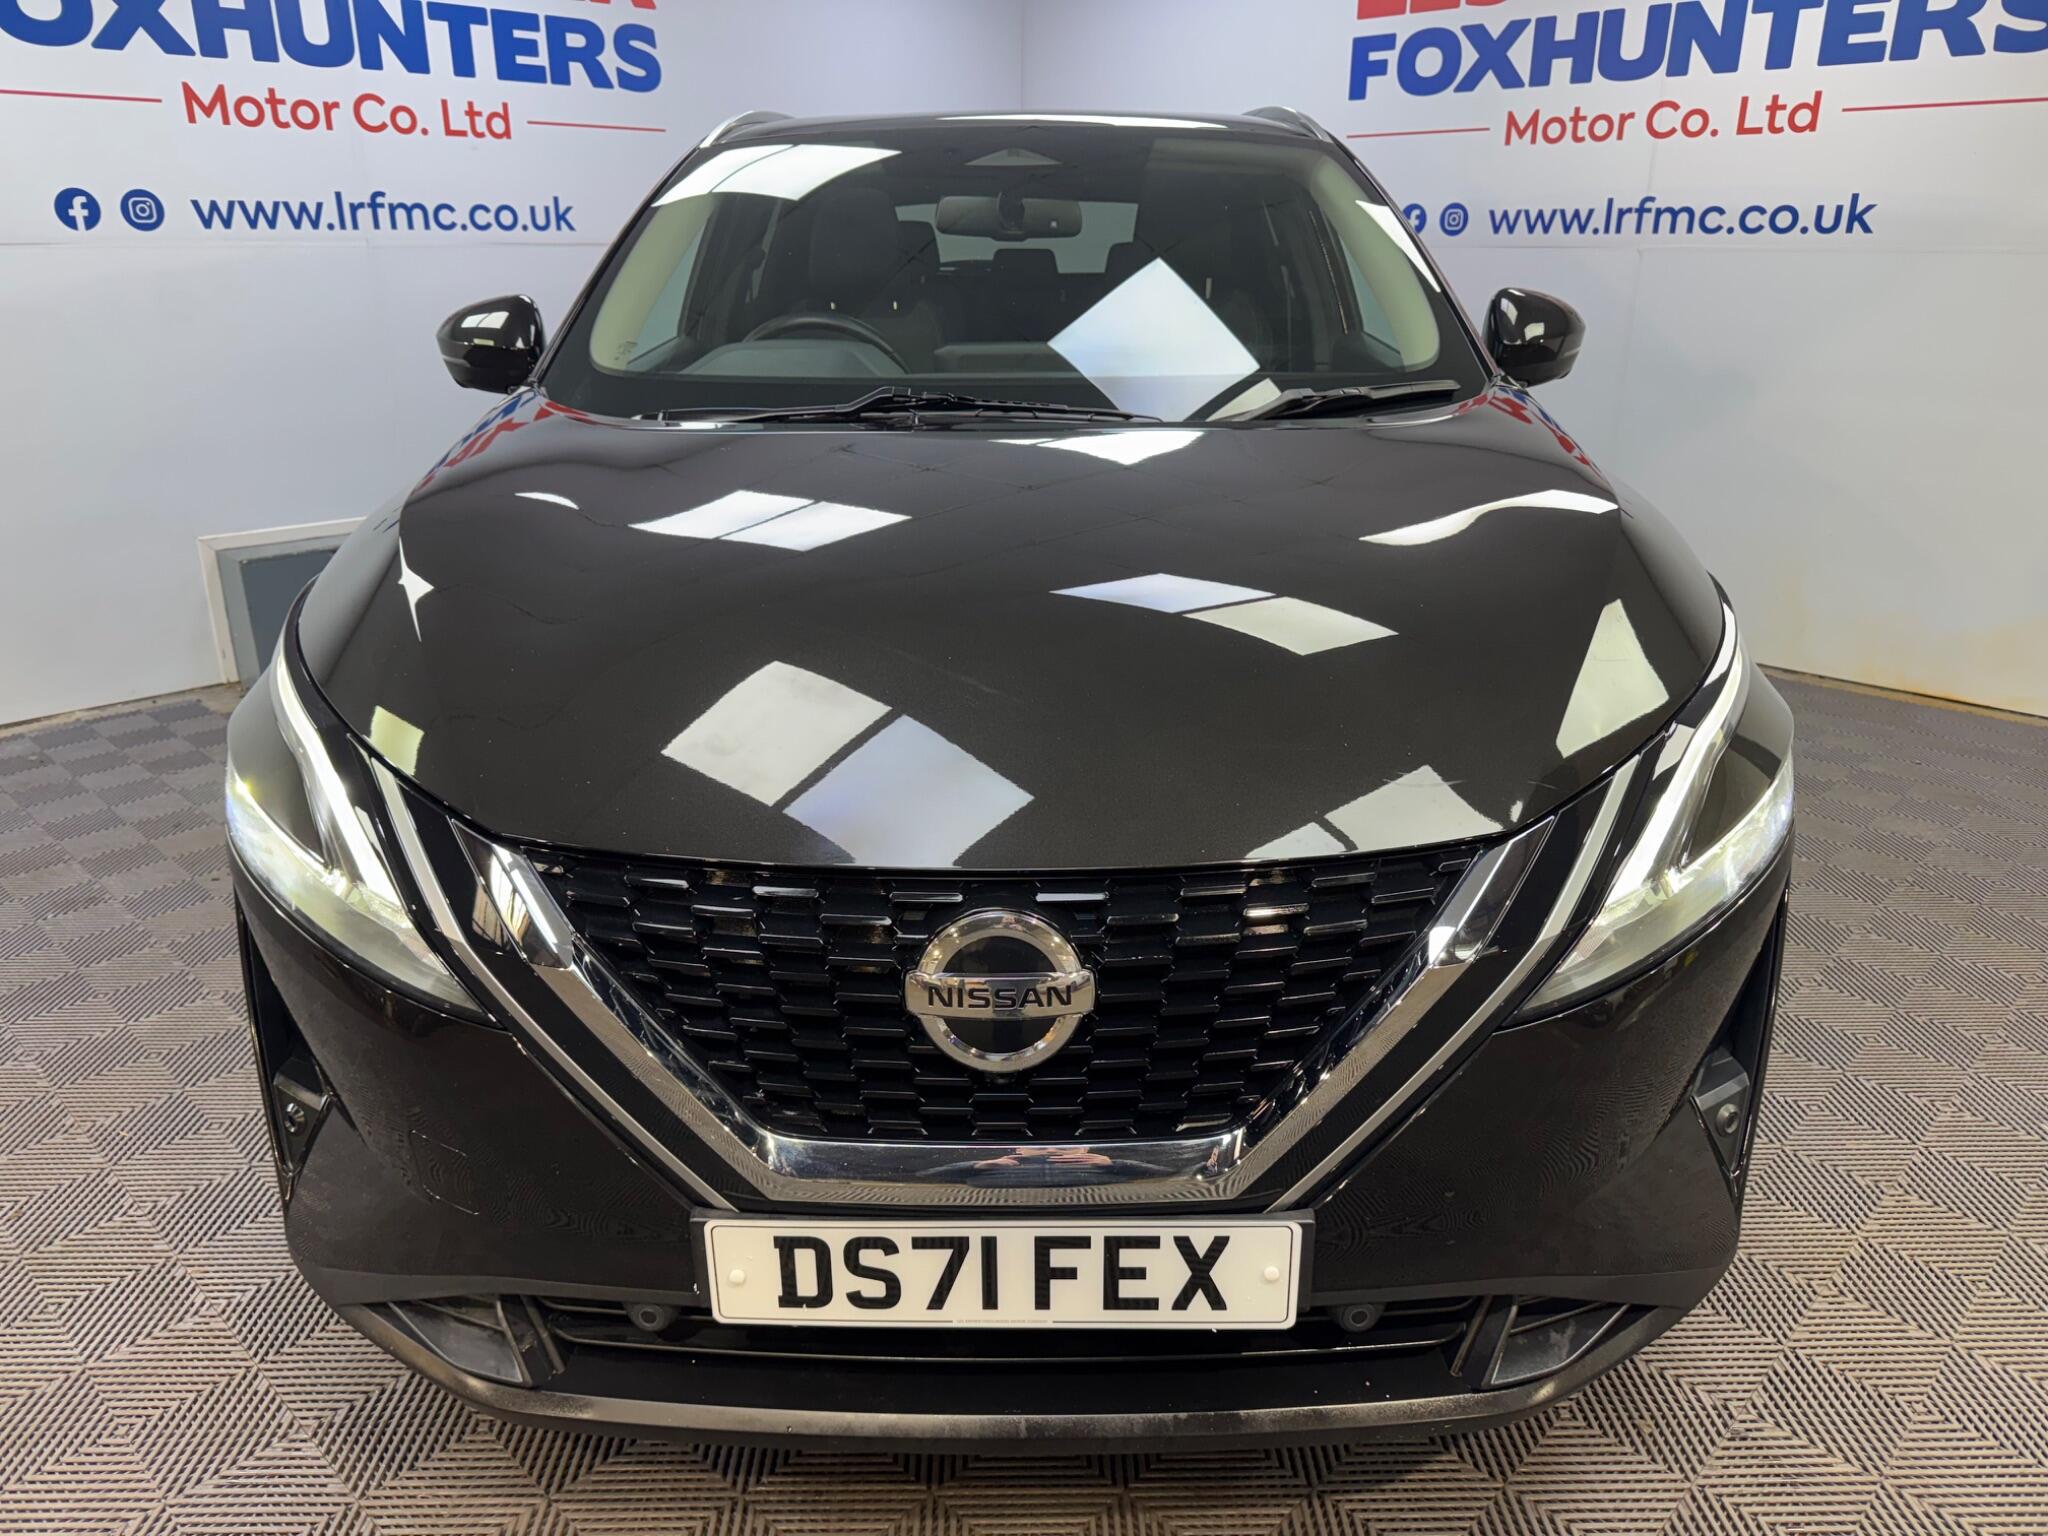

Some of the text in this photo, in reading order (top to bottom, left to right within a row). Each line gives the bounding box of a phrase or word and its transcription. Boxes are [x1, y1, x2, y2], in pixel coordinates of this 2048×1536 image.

[181, 81, 512, 140] Motor Co. Ltd
[1504, 90, 1823, 146] Motor Co. Ltd
[190, 190, 577, 233] www.lrfmc.co.uk
[1489, 193, 1877, 235] www.lrfmc.co.uk
[927, 985, 1073, 1009] NISSAN
[773, 1235, 1231, 1311] DS71 FEX
